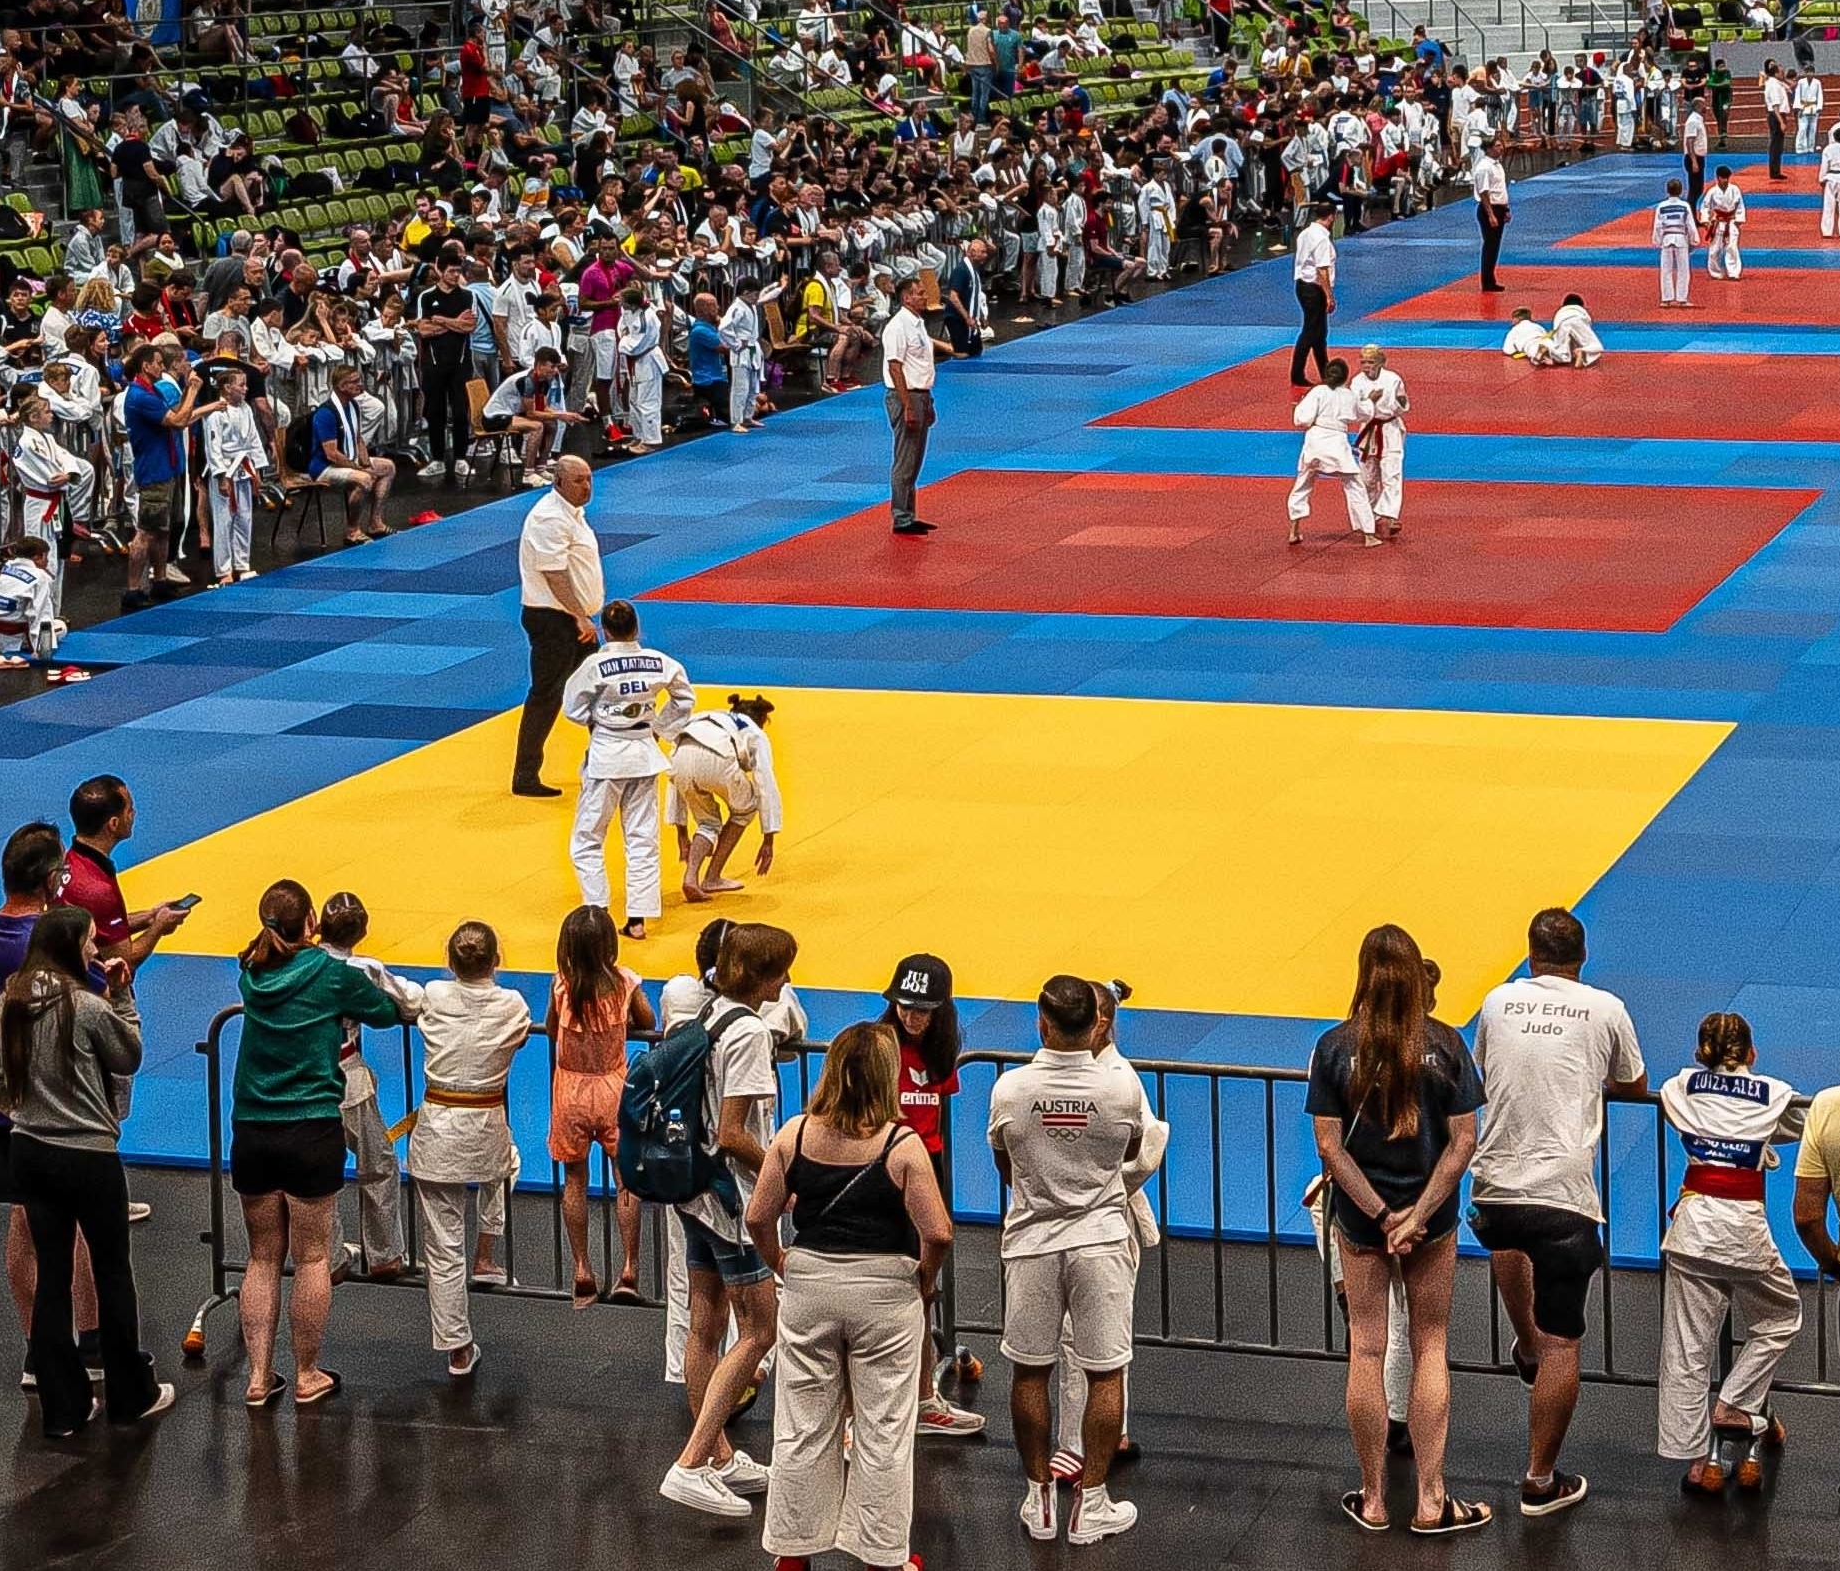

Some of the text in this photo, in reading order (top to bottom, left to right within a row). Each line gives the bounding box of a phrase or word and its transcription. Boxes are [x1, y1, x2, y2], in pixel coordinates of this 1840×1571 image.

[601, 661, 619, 675] VAN
[620, 681, 649, 695] BEL
[1504, 1002, 1591, 1021] PSV Erfurt
[1521, 1021, 1563, 1036] Judo
[1694, 1073, 1761, 1098] LUIZA ALEX
[900, 1089, 939, 1105] erima
[1031, 1100, 1098, 1113] AUSTRIA
